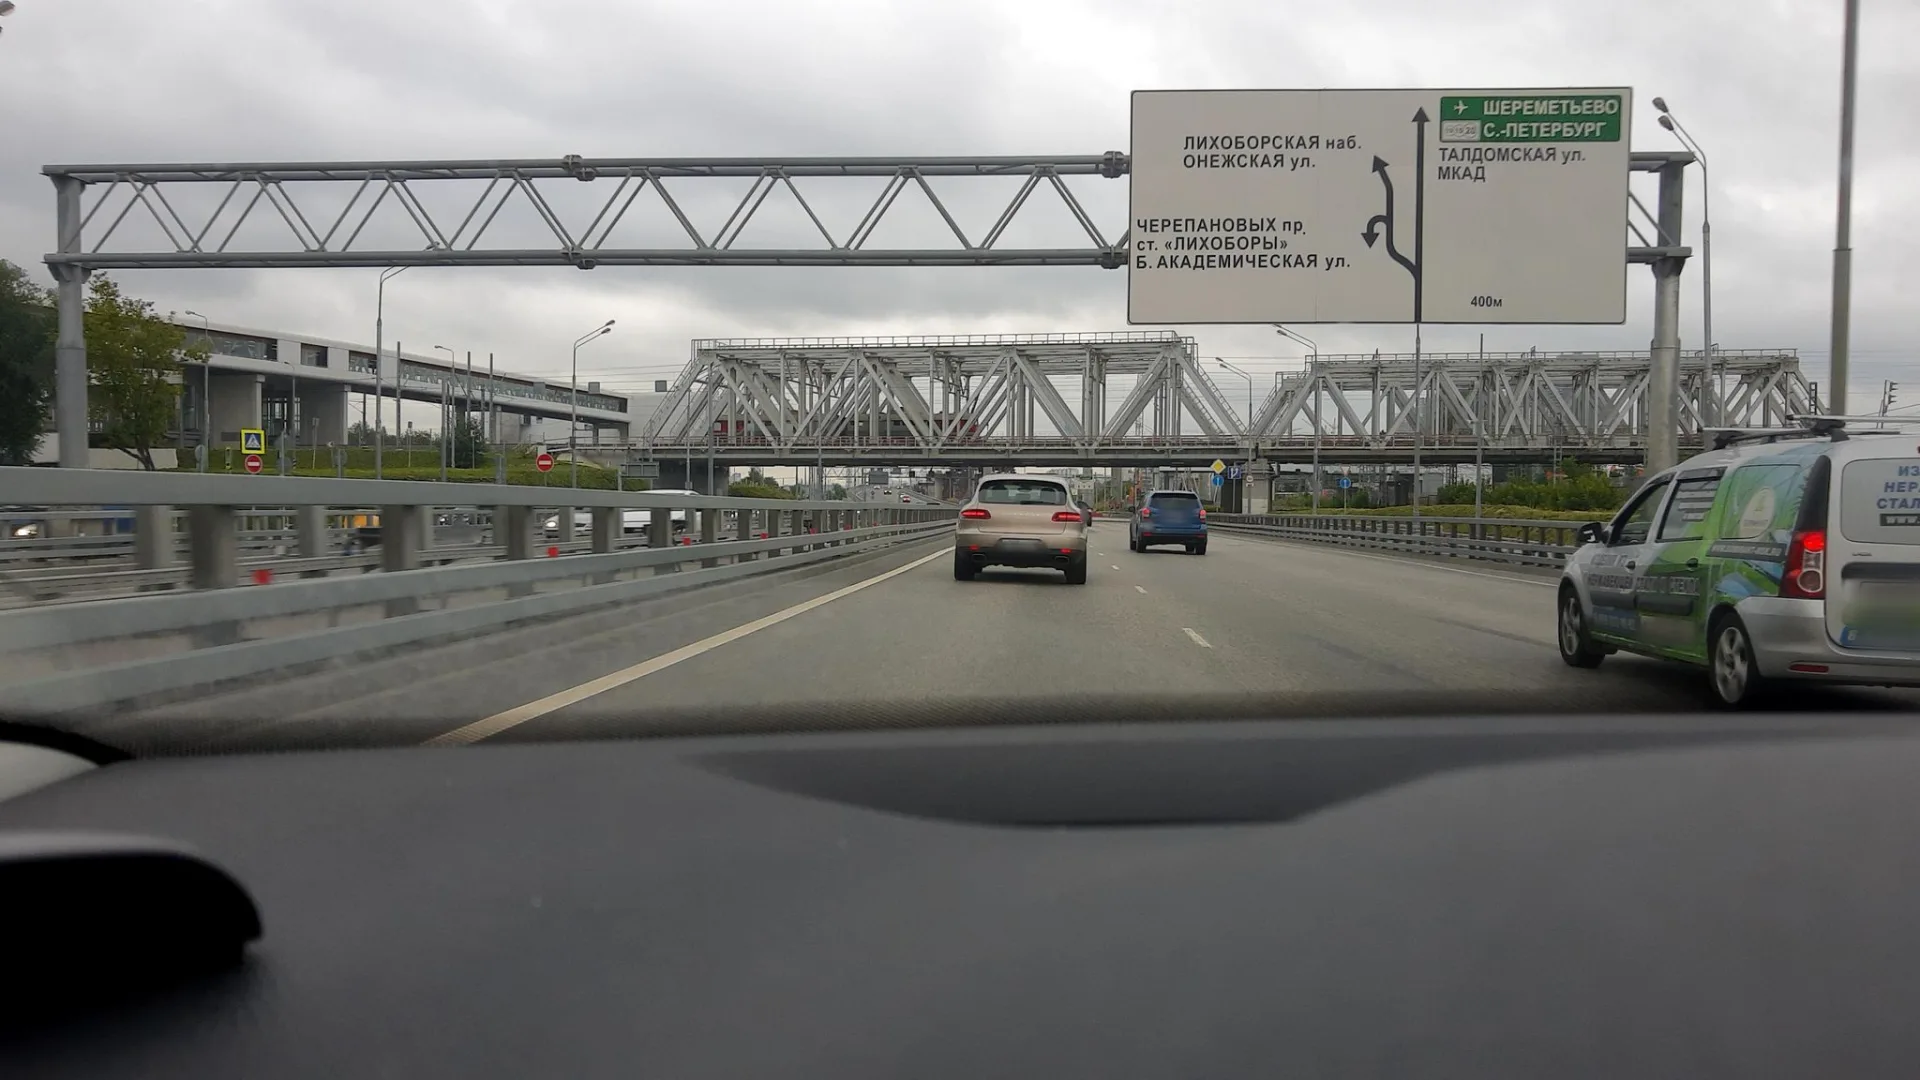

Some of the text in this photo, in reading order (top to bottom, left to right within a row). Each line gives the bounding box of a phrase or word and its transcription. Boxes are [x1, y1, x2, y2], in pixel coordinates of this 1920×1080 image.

[1483, 99, 1619, 116] ШЕРЕМЕТЬЕВО
[1483, 121, 1608, 138] С.-ПЕТЕРБУРГ
[1183, 135, 1362, 151] ЛИХОБОРСКАЯ наб.
[1183, 153, 1317, 172] ОНЕЖСКАЯ ул.
[1438, 147, 1586, 166] ТАЛДОМСКАЯ ул.
[1437, 163, 1486, 182] МКАД
[1136, 217, 1307, 237] ЧЕРЕПАНОВЫХ пр.
[1136, 236, 1288, 252] ст. «ЛИХОБОРЫ»
[1136, 254, 1351, 272] Б. АКАДЕМИЧЕСКАЯ ул.
[1470, 295, 1503, 308] 400м
[1883, 481, 1920, 493] НЕР
